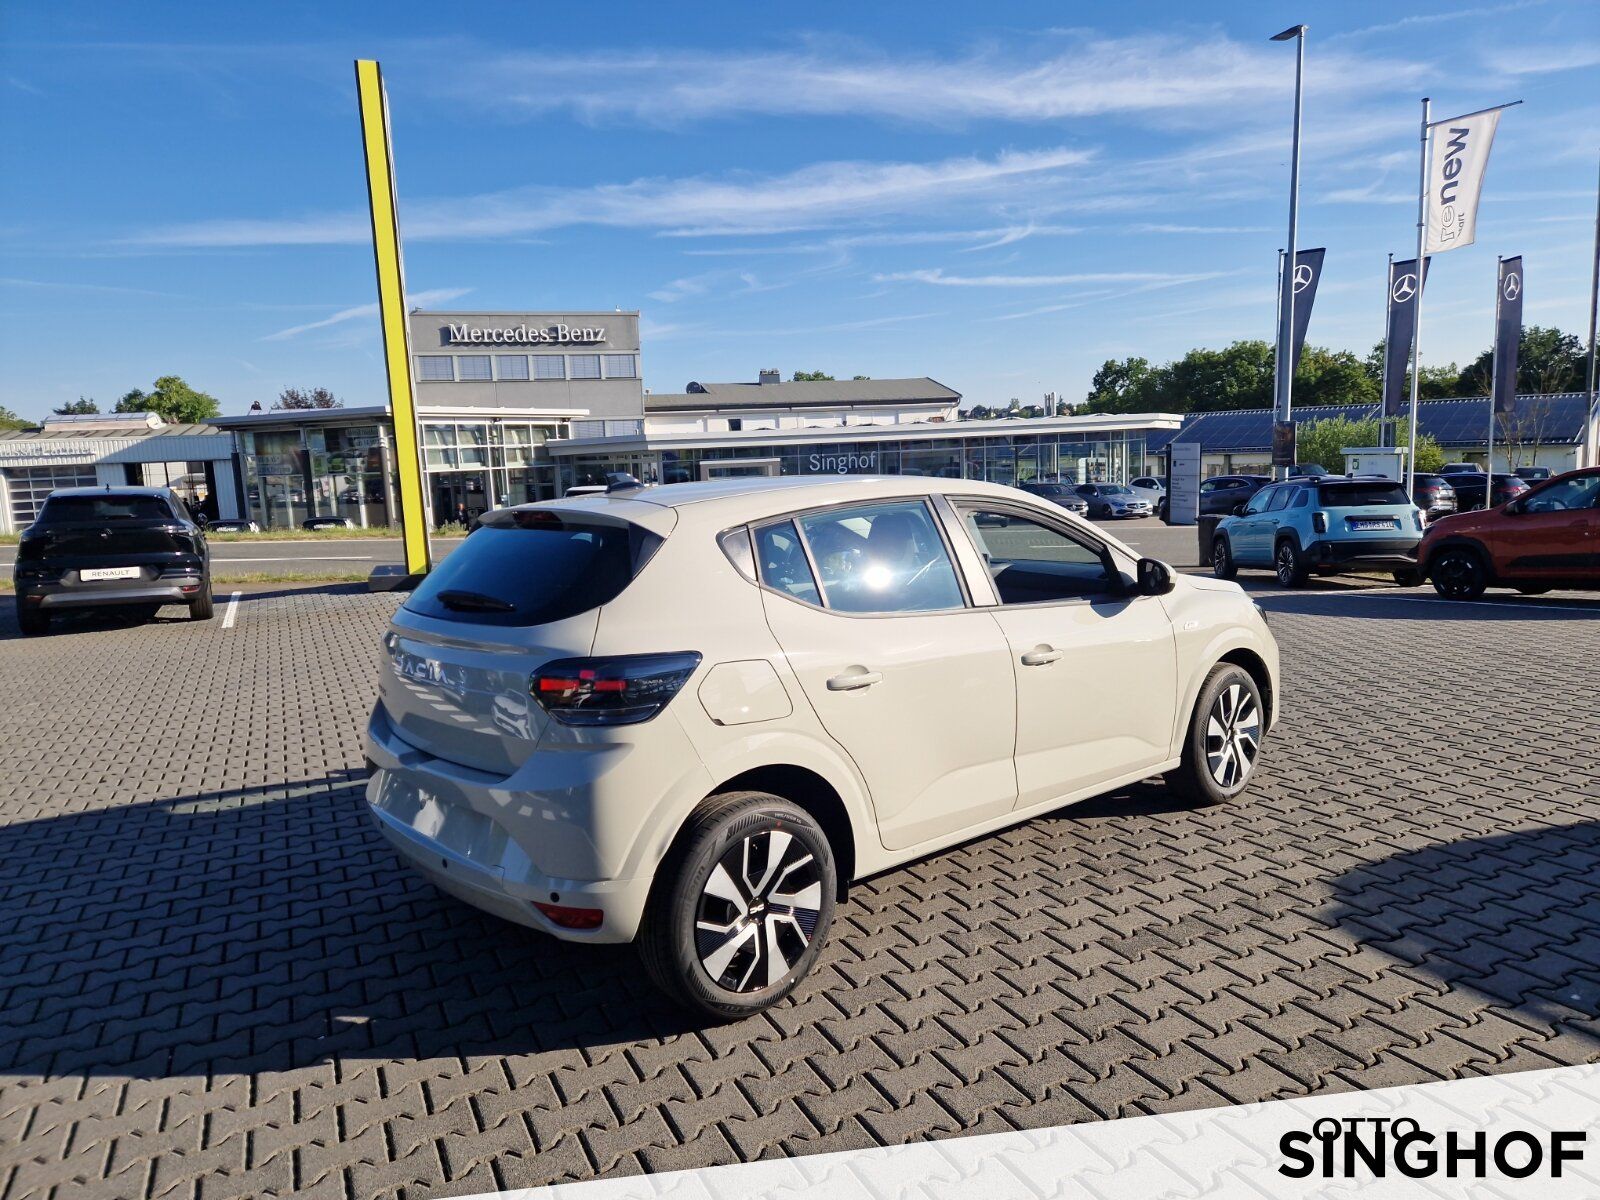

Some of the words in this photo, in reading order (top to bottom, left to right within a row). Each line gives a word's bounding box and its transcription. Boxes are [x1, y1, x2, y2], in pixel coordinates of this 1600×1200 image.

[1440, 128, 1470, 242] renew
[448, 323, 606, 343] Mercedes-Benz
[809, 451, 877, 474] Singhof
[91, 569, 129, 577] RENAULT
